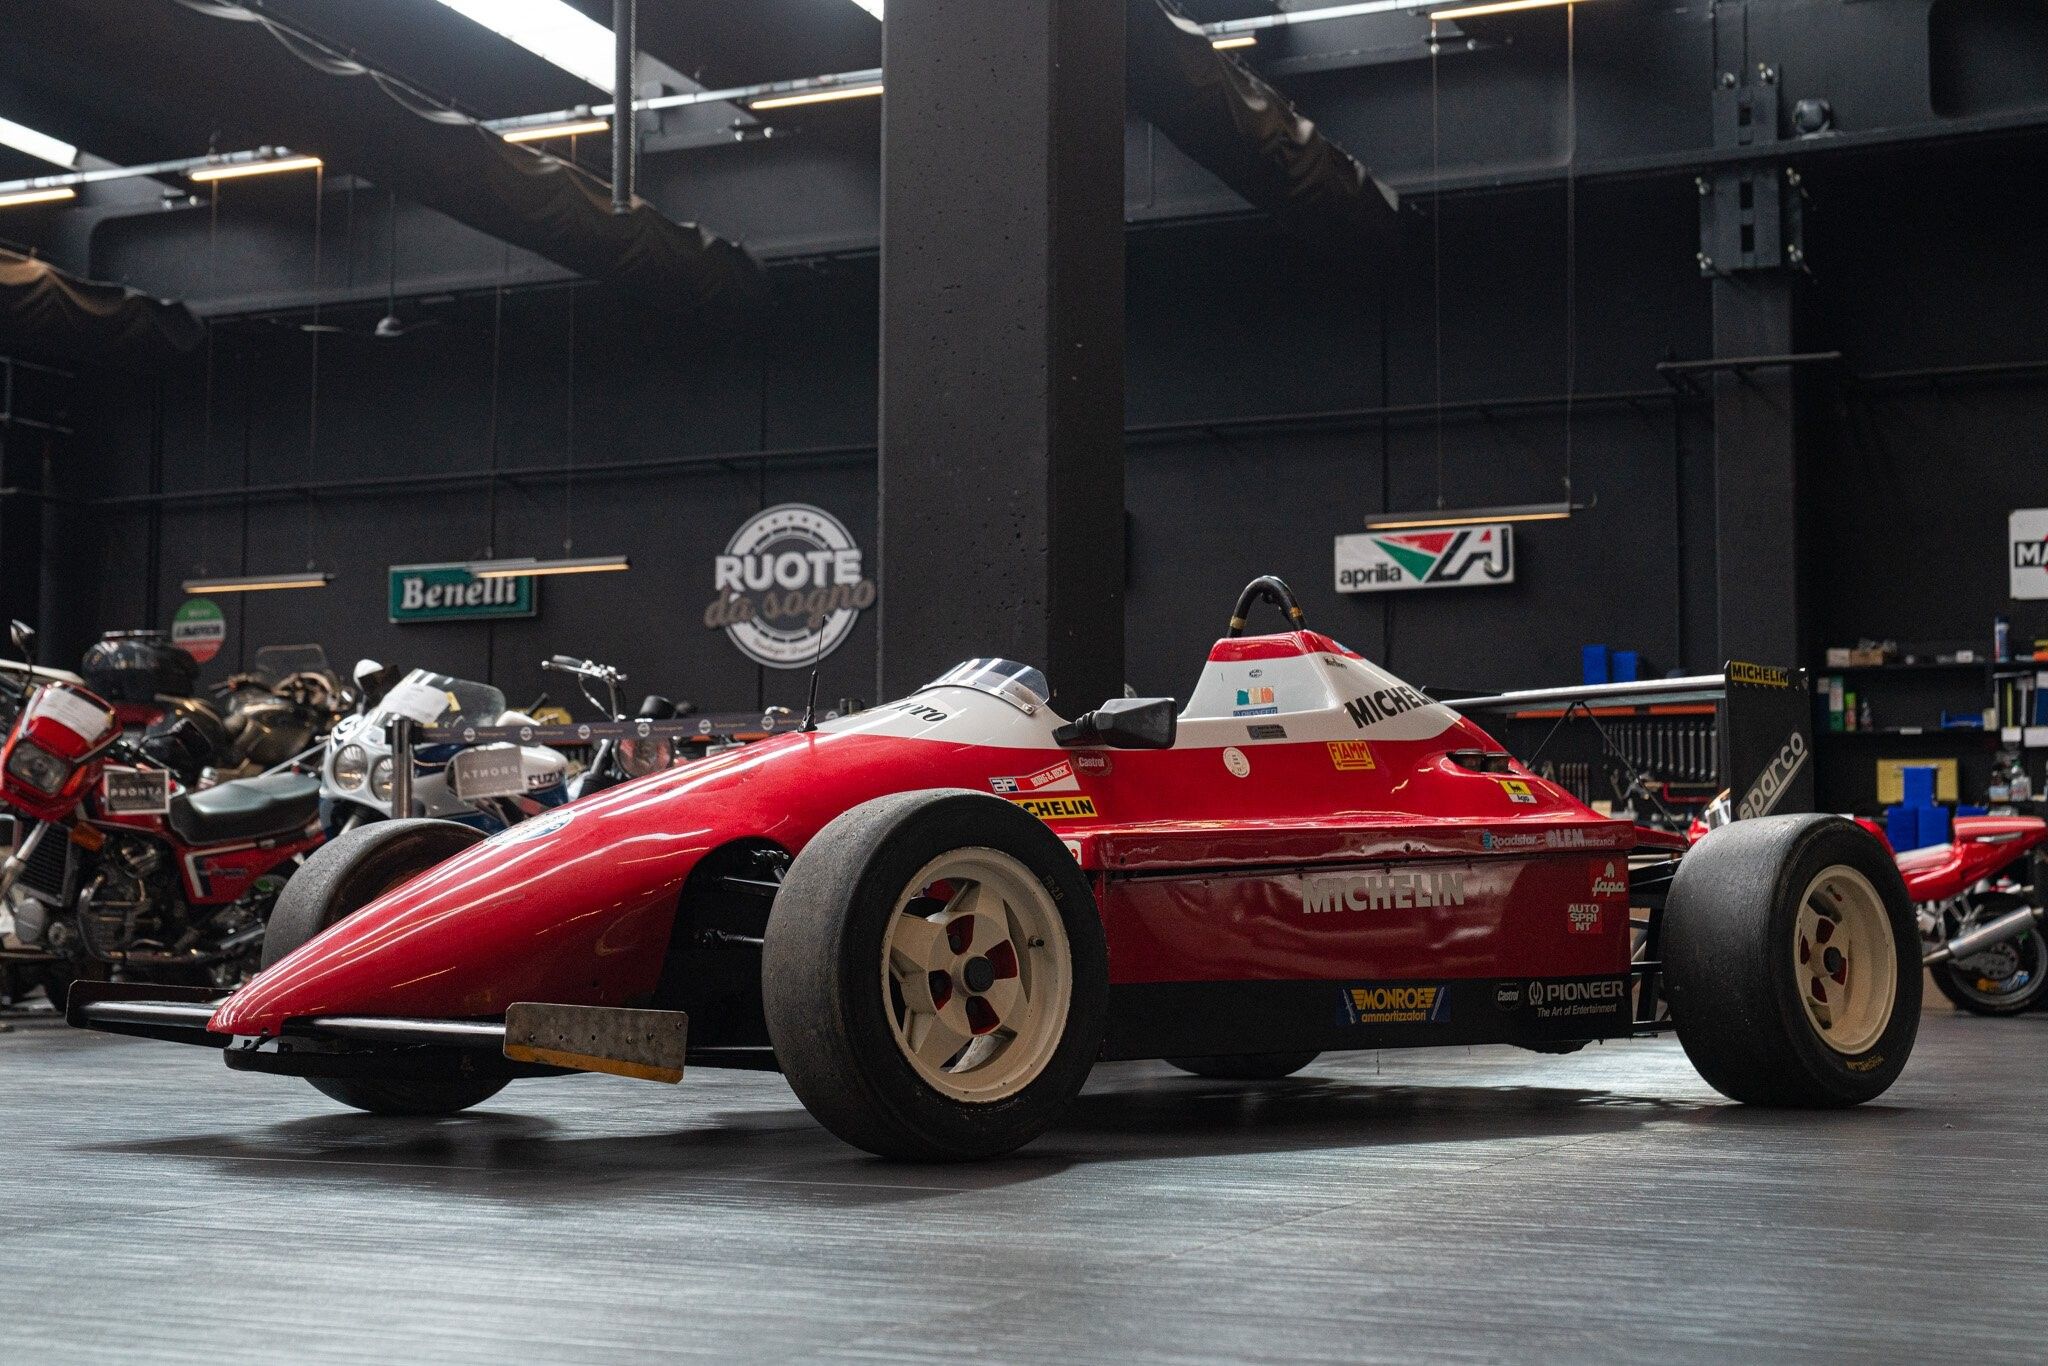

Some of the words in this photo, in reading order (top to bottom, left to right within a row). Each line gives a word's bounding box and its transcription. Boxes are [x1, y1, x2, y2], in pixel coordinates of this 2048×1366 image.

[715, 550, 863, 592] RUOTE
[1339, 562, 1402, 587] aprilia
[401, 576, 516, 609] Benelli
[1733, 664, 1788, 685] MICHELIN
[1328, 742, 1369, 760] FIAMM
[1078, 757, 1105, 767] Castrol
[1017, 801, 1095, 817] CHELIN
[1491, 832, 1537, 849] Roadstar
[1302, 873, 1465, 914] MICHELIN
[1568, 904, 1600, 913] AUTO
[1569, 912, 1598, 923] SPRI
[1575, 922, 1592, 931] NT
[1360, 987, 1427, 1010] MONROE
[1497, 990, 1520, 1002] Castrol
[1547, 980, 1624, 1001] PIONEER
[1361, 1009, 1427, 1023] ammortizzatori
[1537, 1007, 1551, 1018] The
[1552, 1006, 1563, 1017] Art
[1563, 1005, 1572, 1016] of
[1572, 1003, 1617, 1015] Entertainment
